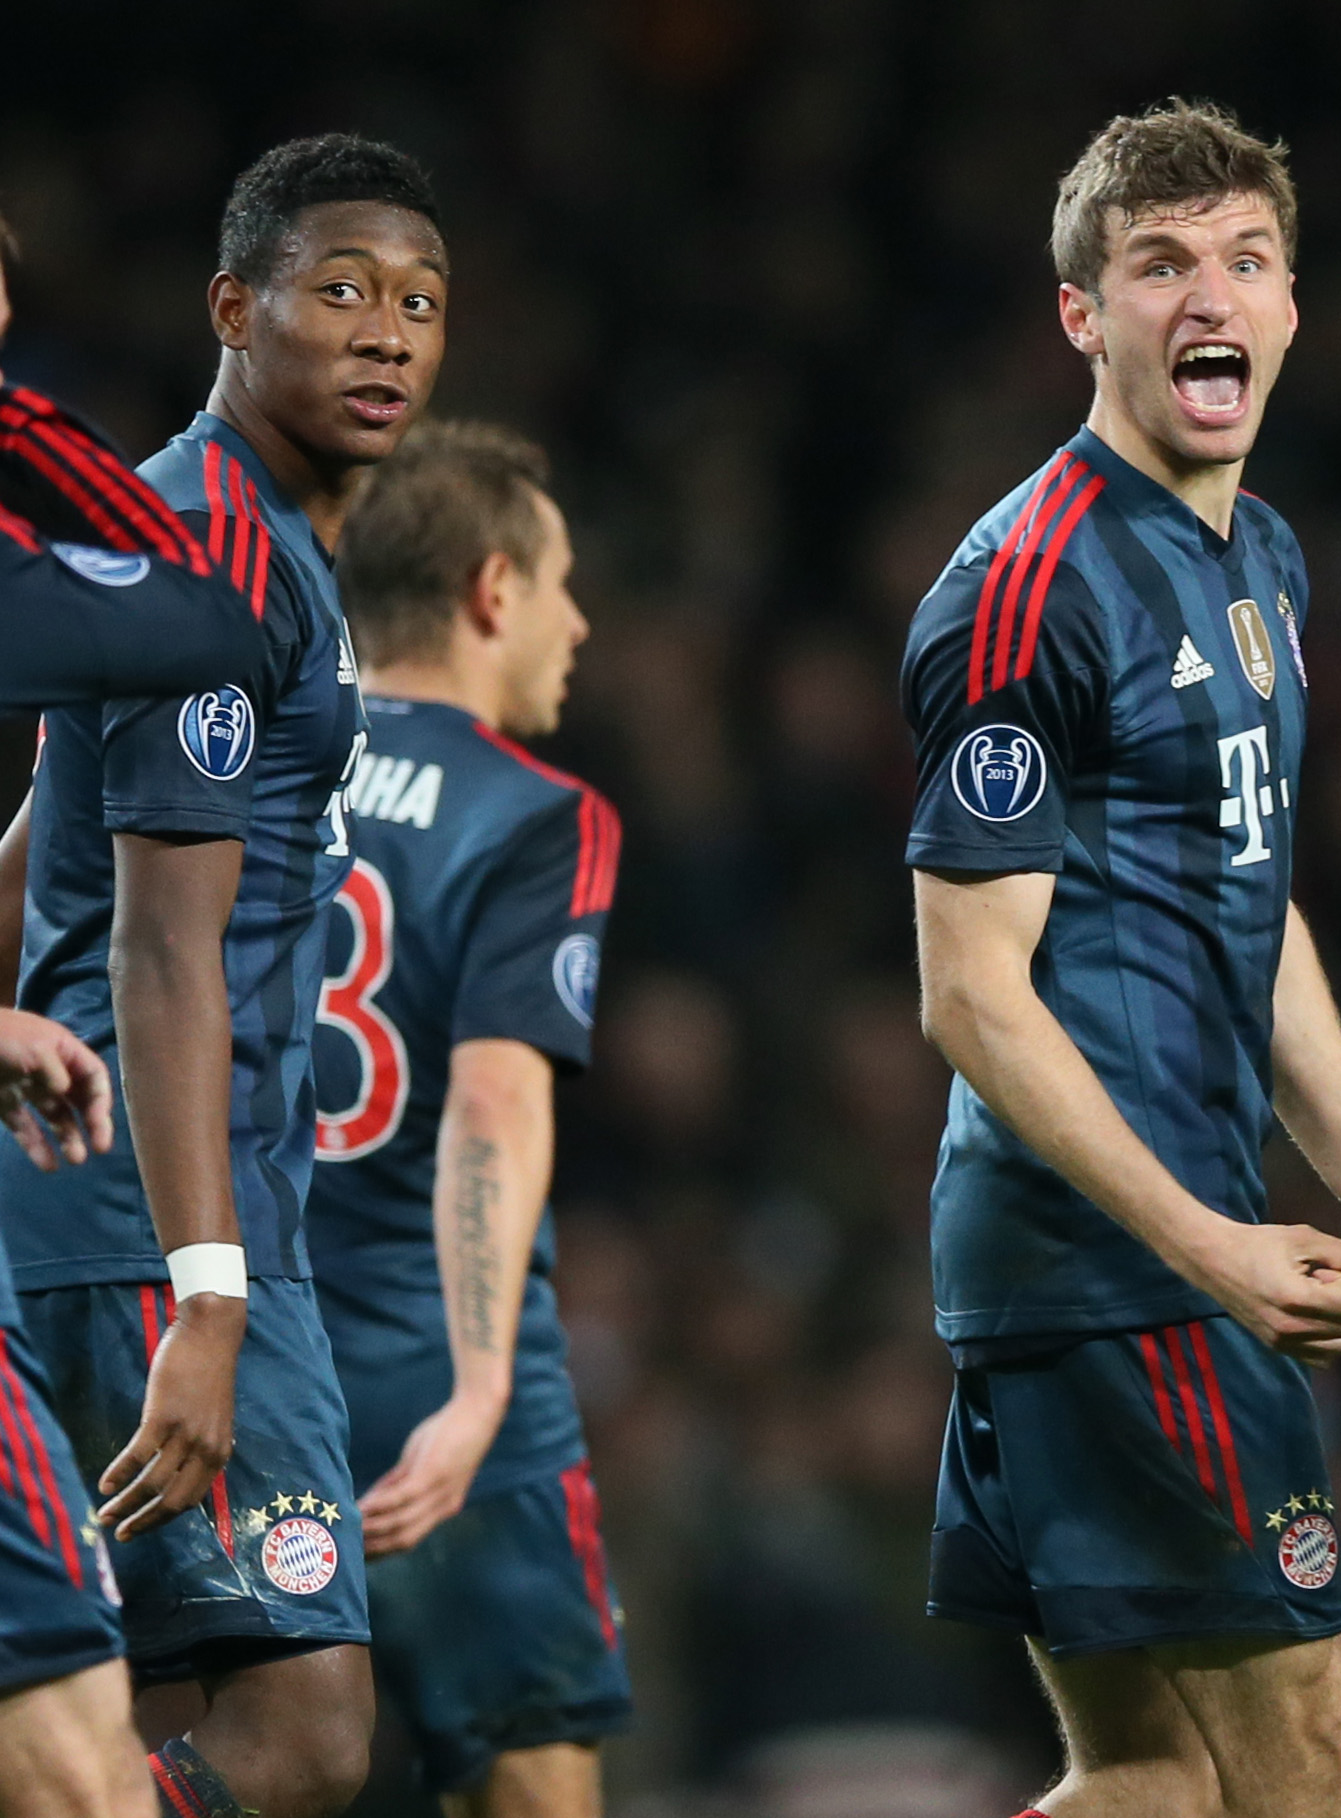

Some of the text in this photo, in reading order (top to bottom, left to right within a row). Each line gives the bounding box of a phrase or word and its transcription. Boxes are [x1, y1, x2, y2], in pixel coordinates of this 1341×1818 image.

[1170, 662, 1215, 689] adidas
[986, 767, 1014, 781] 2013
[266, 1521, 333, 1555] FC BAYERN
